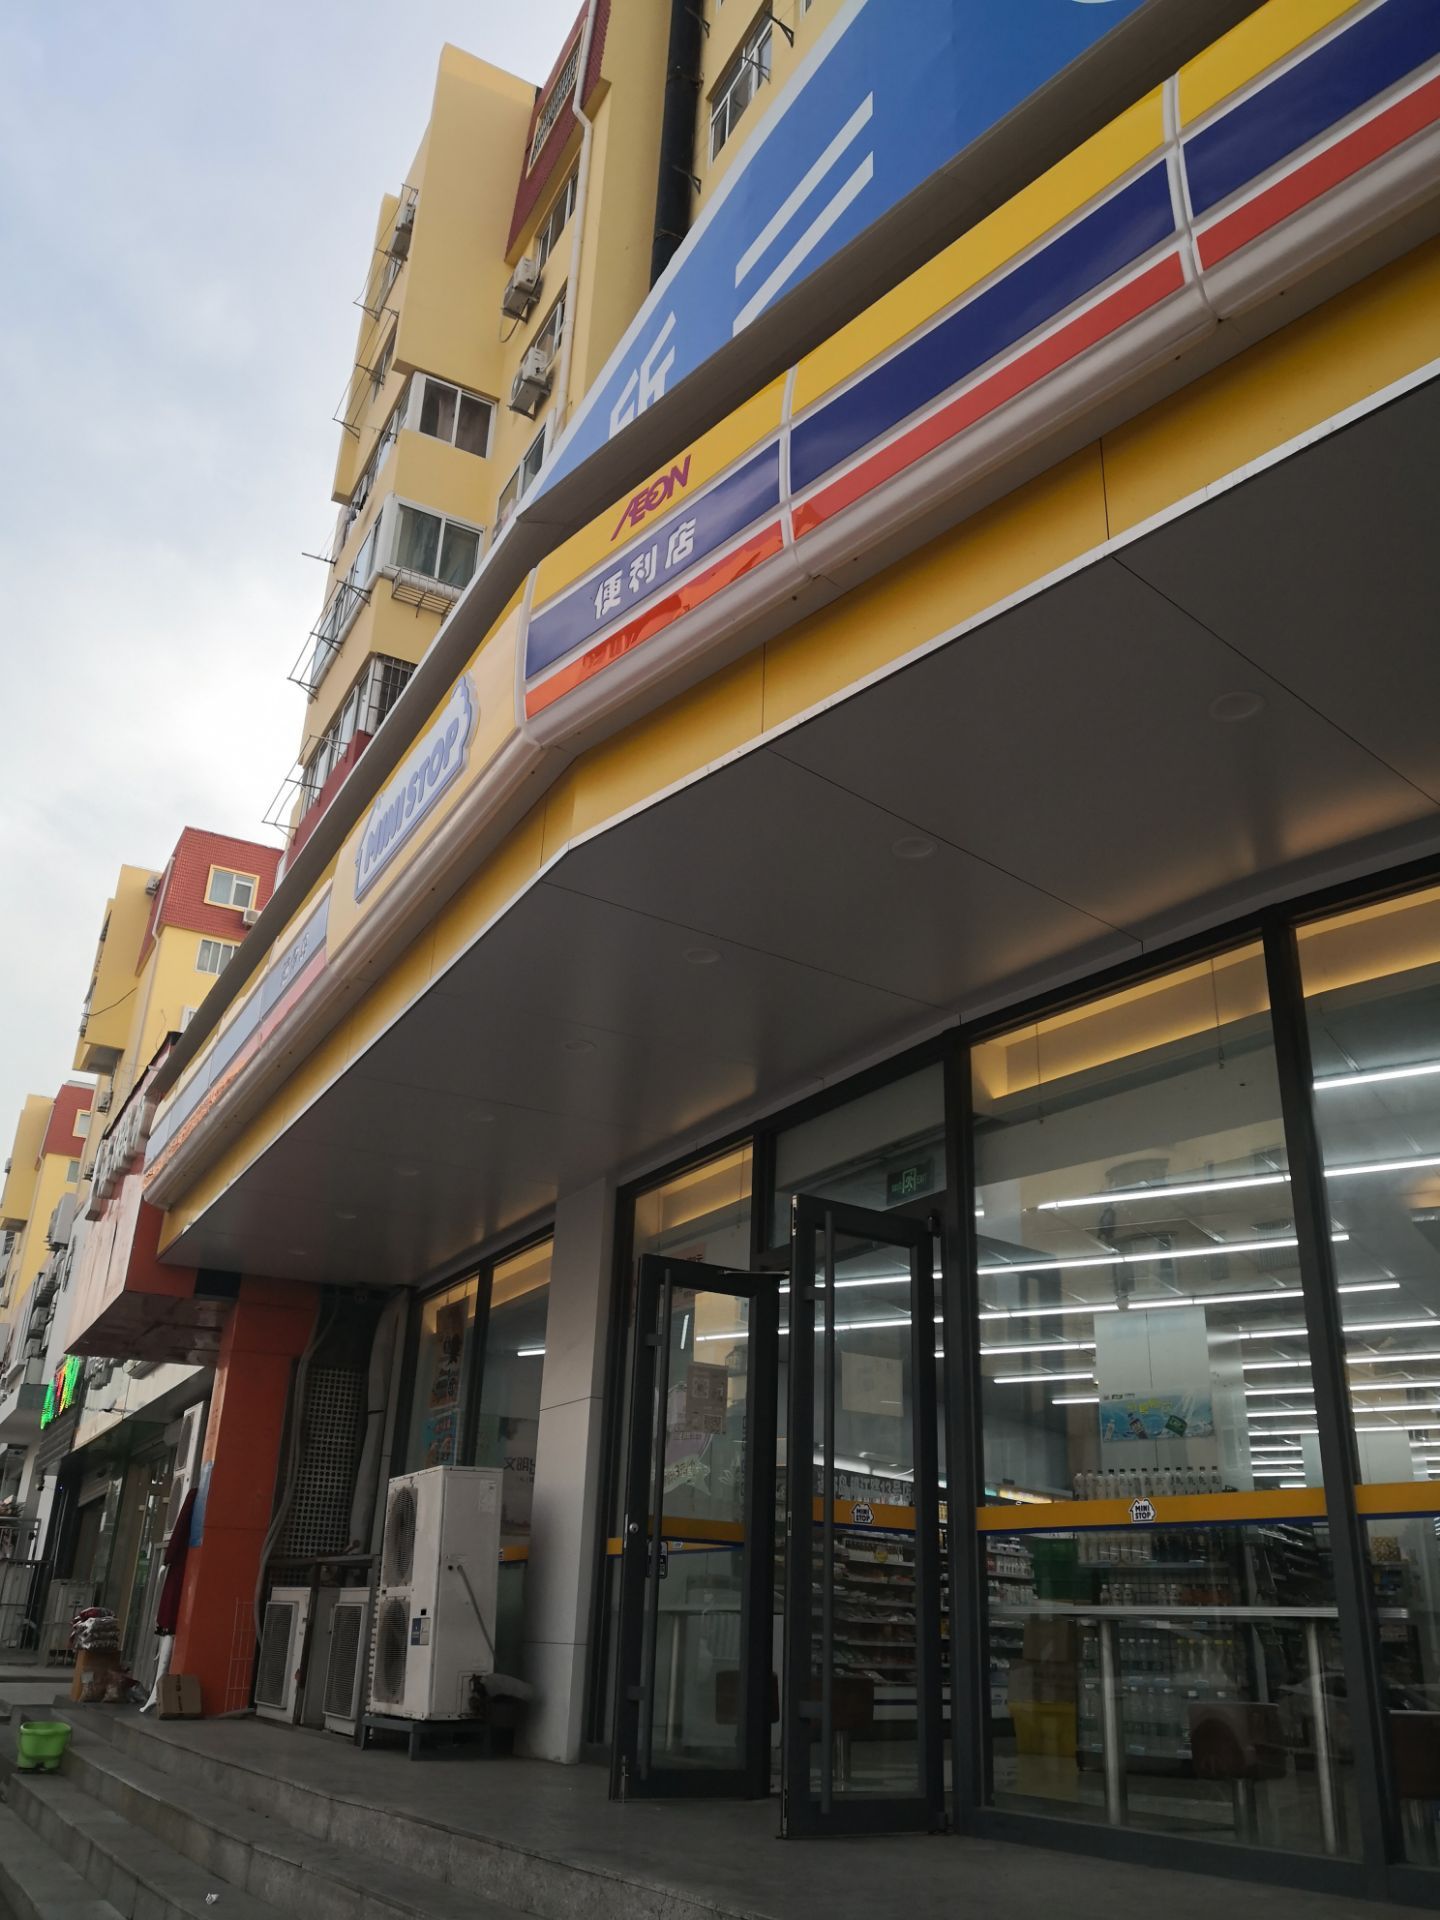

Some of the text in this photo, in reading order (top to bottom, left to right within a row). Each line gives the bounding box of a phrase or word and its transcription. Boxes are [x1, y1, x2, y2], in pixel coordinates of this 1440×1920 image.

[594, 517, 696, 620] 便利店
[404, 717, 460, 819] STOP
